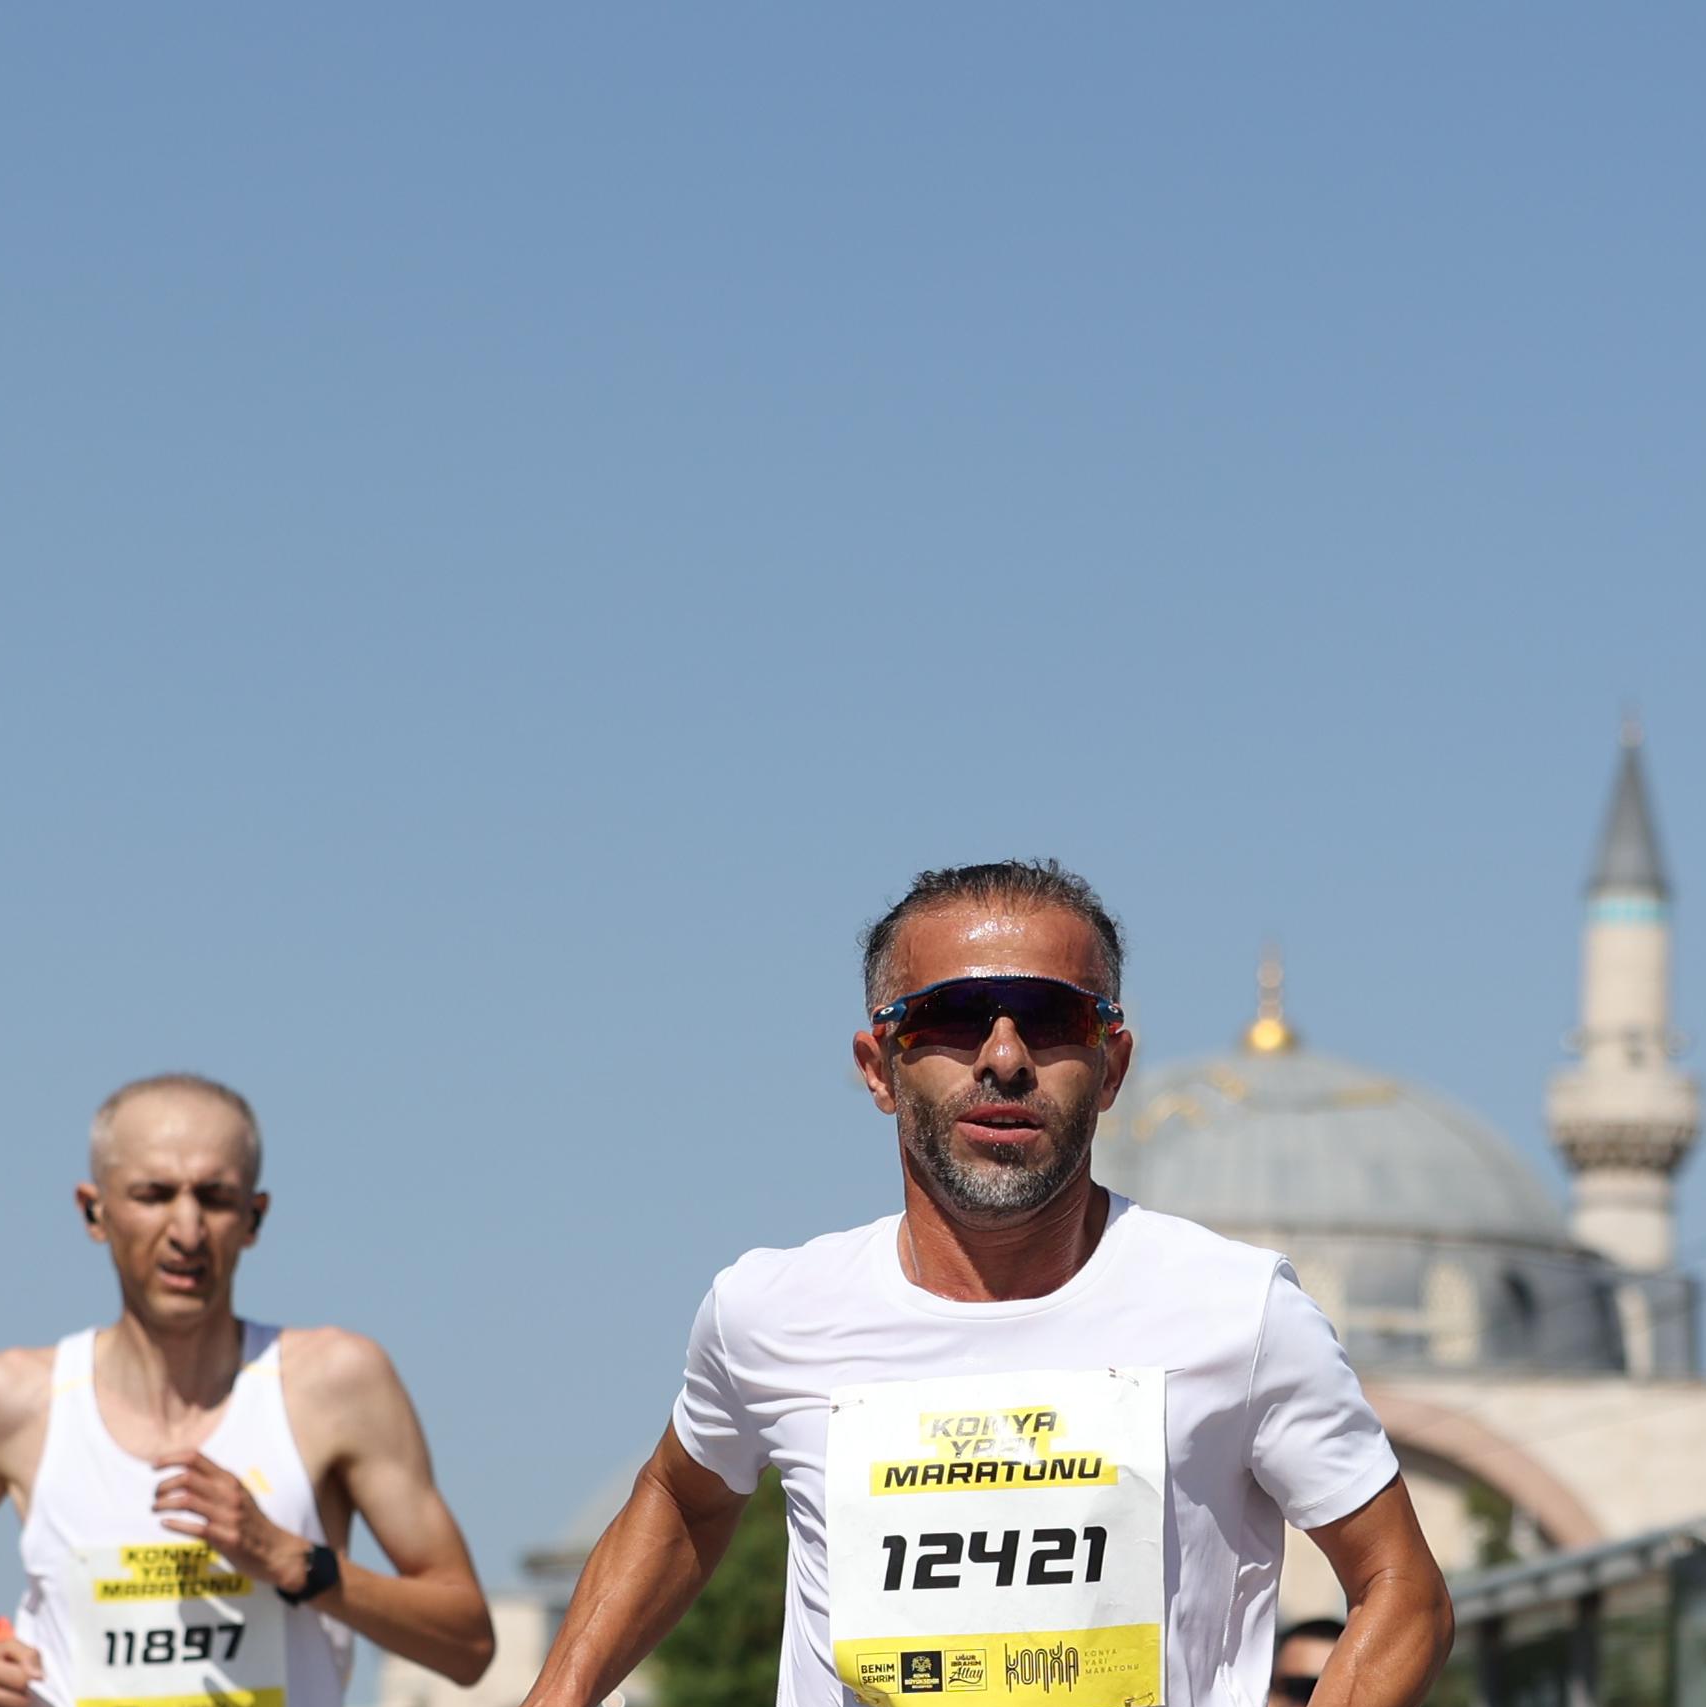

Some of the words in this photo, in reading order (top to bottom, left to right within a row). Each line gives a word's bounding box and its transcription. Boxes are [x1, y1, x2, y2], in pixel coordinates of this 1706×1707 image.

[884, 1457, 1103, 1488] MARATONU
[882, 1526, 1108, 1591] 12421
[105, 1624, 245, 1666] 11897
[861, 1663, 895, 1674] BENİM
